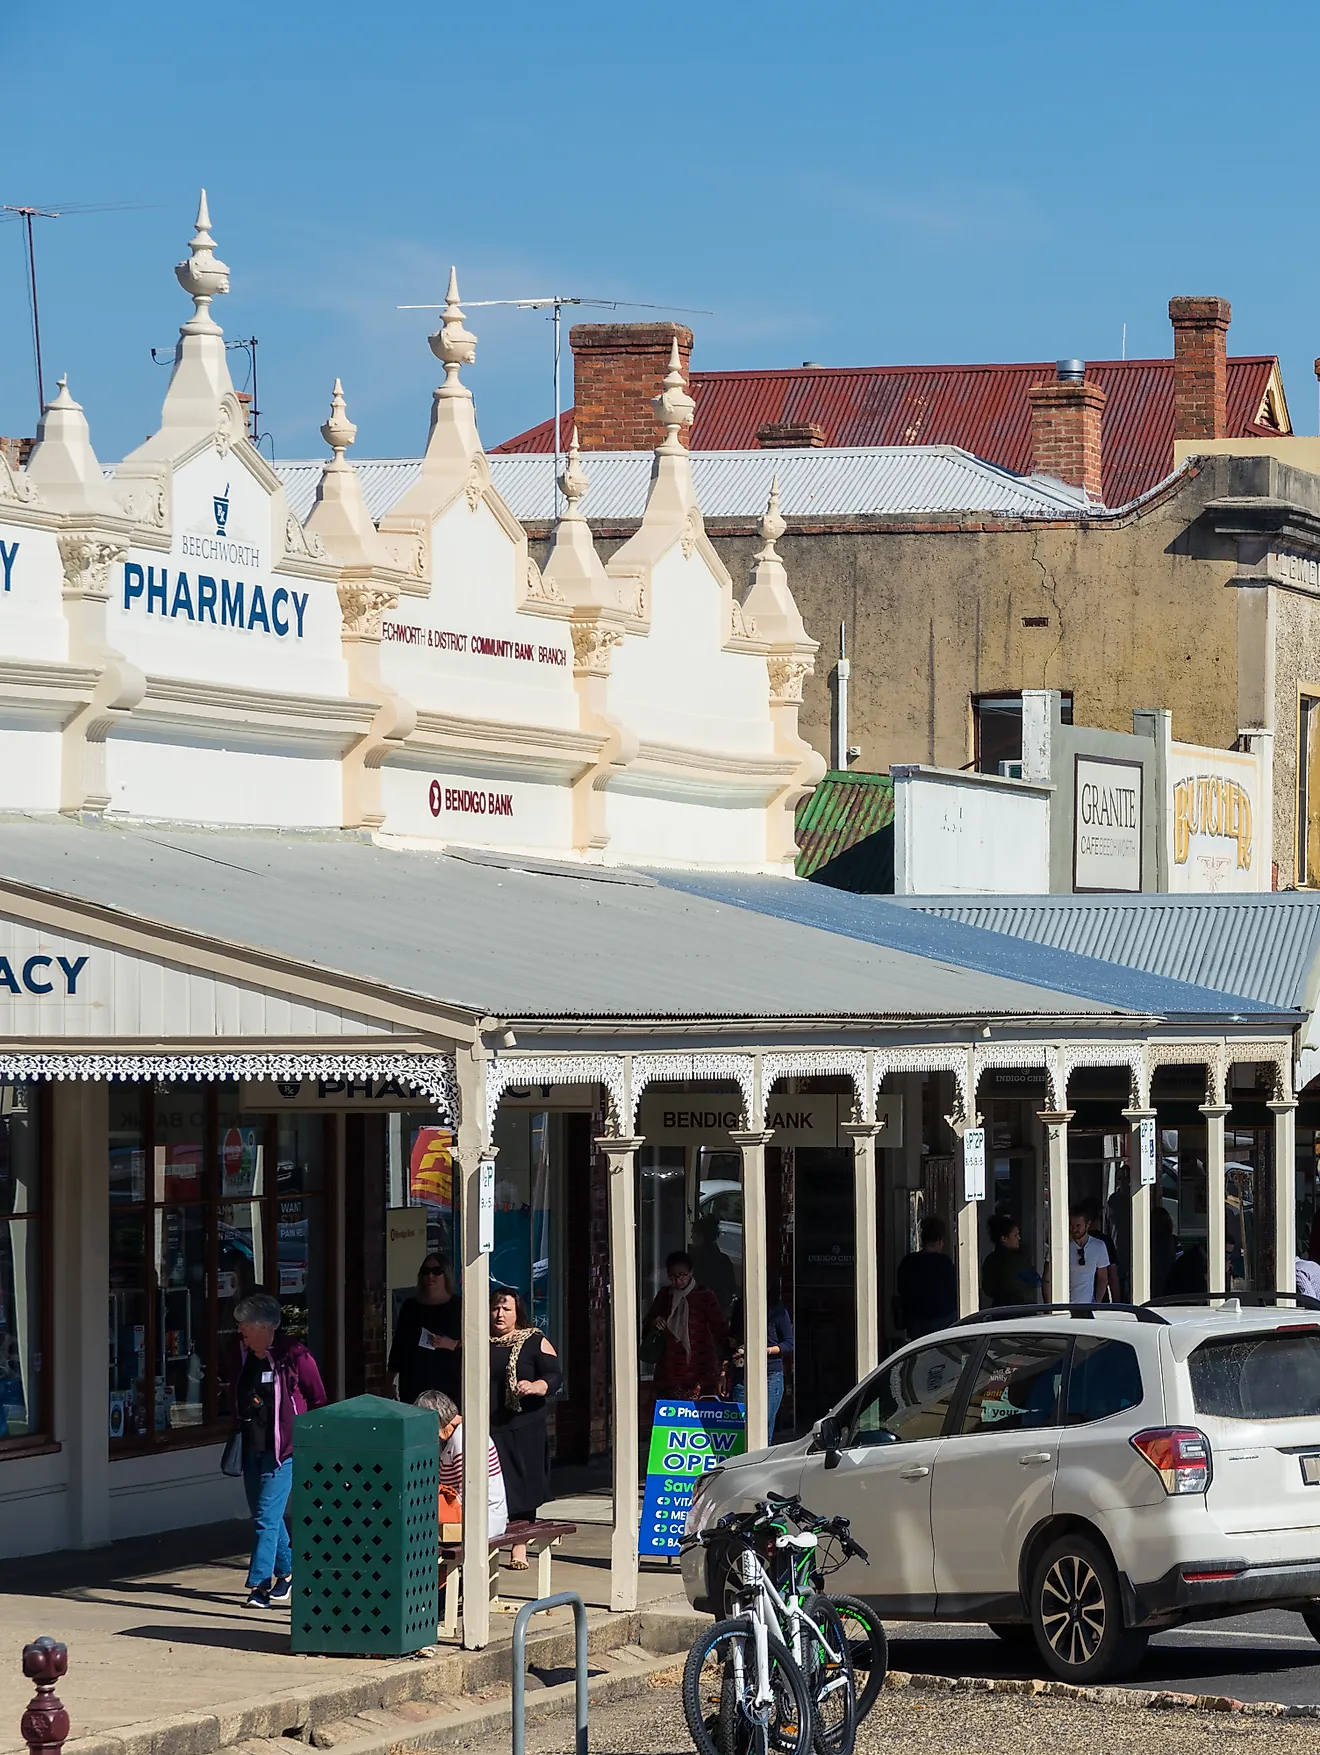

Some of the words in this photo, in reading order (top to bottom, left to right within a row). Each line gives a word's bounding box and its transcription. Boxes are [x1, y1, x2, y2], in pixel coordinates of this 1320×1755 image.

[182, 535, 260, 568] BEECHWORTH
[124, 562, 309, 638] PHARMACY
[428, 630, 433, 647] &
[435, 631, 468, 653] DISTRICT
[471, 636, 513, 659] COMMUNITY
[515, 642, 534, 662] BANK
[538, 646, 566, 666] BRANCH
[445, 788, 486, 814] BENDIGO
[488, 793, 513, 816] BANK
[1081, 782, 1137, 830] GRANITE
[1173, 774, 1253, 871] BUTCHER
[0, 955, 90, 995] ACY
[995, 1075, 1025, 1083] INDIGO
[663, 1111, 742, 1129] BENDIG
[667, 1430, 737, 1452] NOW
